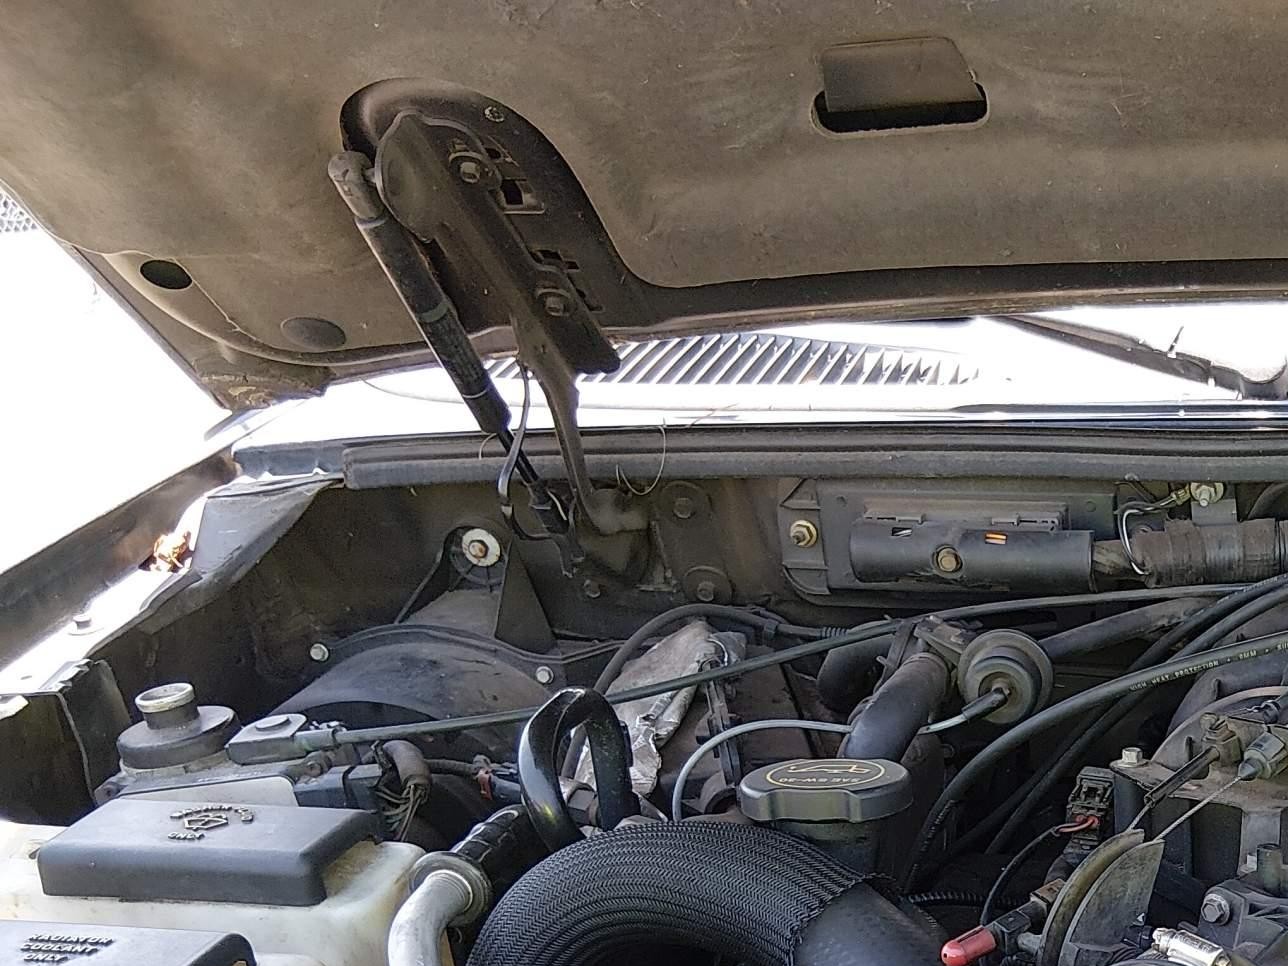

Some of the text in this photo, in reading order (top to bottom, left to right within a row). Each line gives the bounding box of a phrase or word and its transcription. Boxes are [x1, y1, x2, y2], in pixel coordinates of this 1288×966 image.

[168, 831, 206, 841] ONLY
[29, 934, 115, 947] RADIATOR
[20, 942, 100, 956] COOLANT
[23, 953, 69, 965] ONLY
